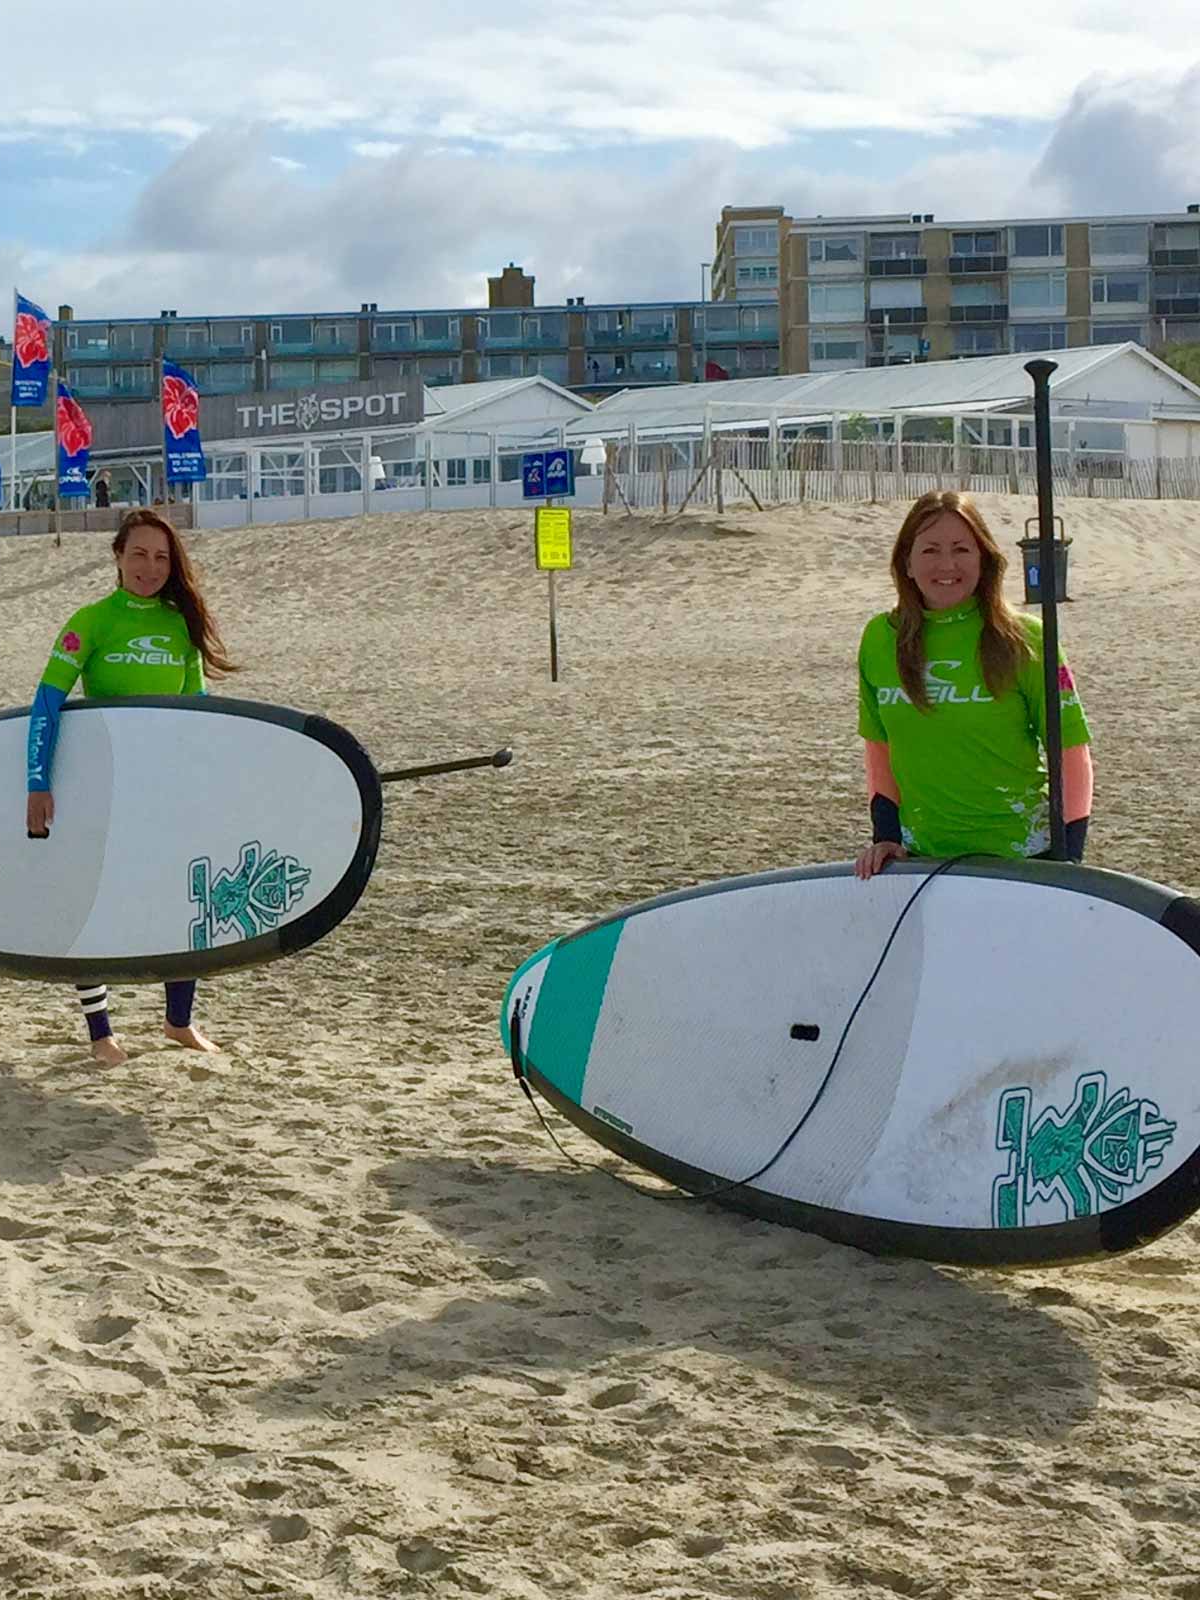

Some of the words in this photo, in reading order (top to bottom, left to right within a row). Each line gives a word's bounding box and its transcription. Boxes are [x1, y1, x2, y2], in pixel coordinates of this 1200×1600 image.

[237, 402, 296, 428] THE
[320, 391, 407, 421] SPOT
[29, 716, 47, 766] Hurley
